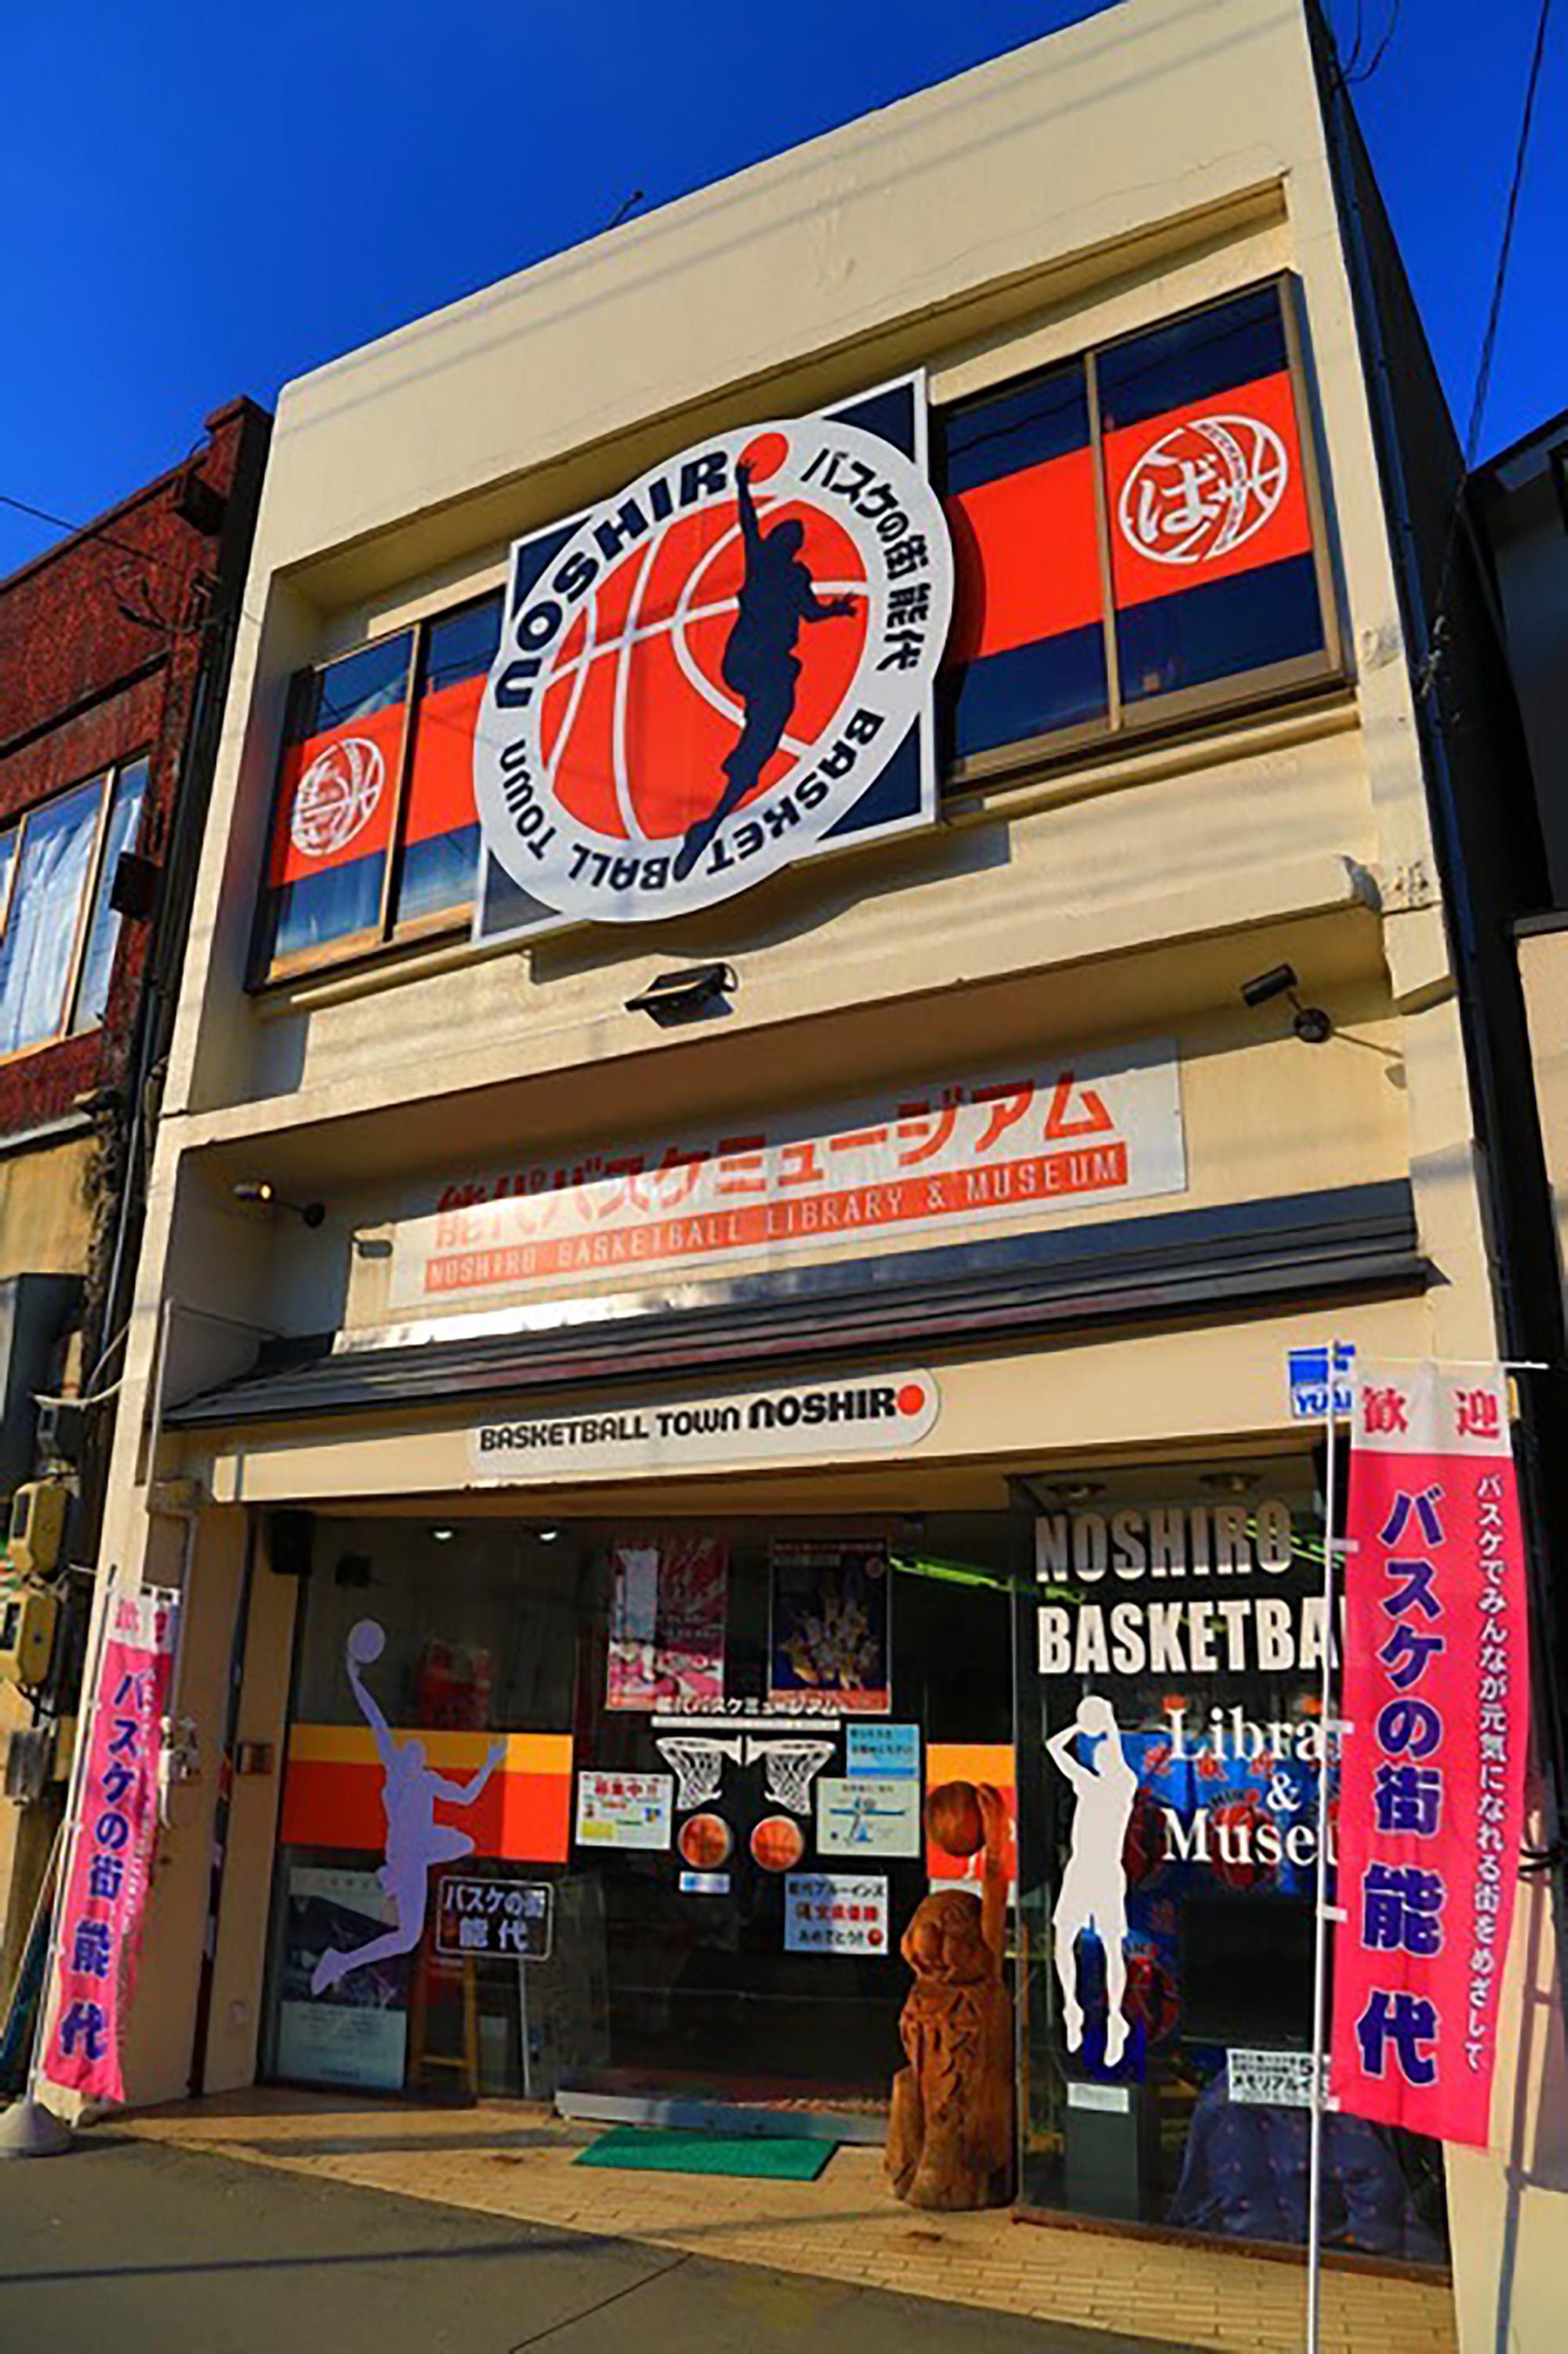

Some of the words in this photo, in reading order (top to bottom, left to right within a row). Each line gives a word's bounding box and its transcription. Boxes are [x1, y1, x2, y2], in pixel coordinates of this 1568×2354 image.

[706, 708, 885, 875] BASKET
[568, 842, 681, 892] BALL
[434, 1070, 1115, 1248] 能代バスケミュージアム
[430, 1248, 537, 1284] NOSHIRO
[557, 1214, 742, 1266] BASKETBALL
[765, 1186, 903, 1236] LIBRARY
[926, 1181, 947, 1211] &
[966, 1150, 1120, 1202] MUSEUM
[479, 1415, 649, 1451] BASKETBALL
[656, 1406, 741, 1437] TOWN
[1035, 1499, 1294, 1583] NOSHIRO
[1167, 1706, 1341, 1762] Libra
[1266, 1771, 1302, 1811] &
